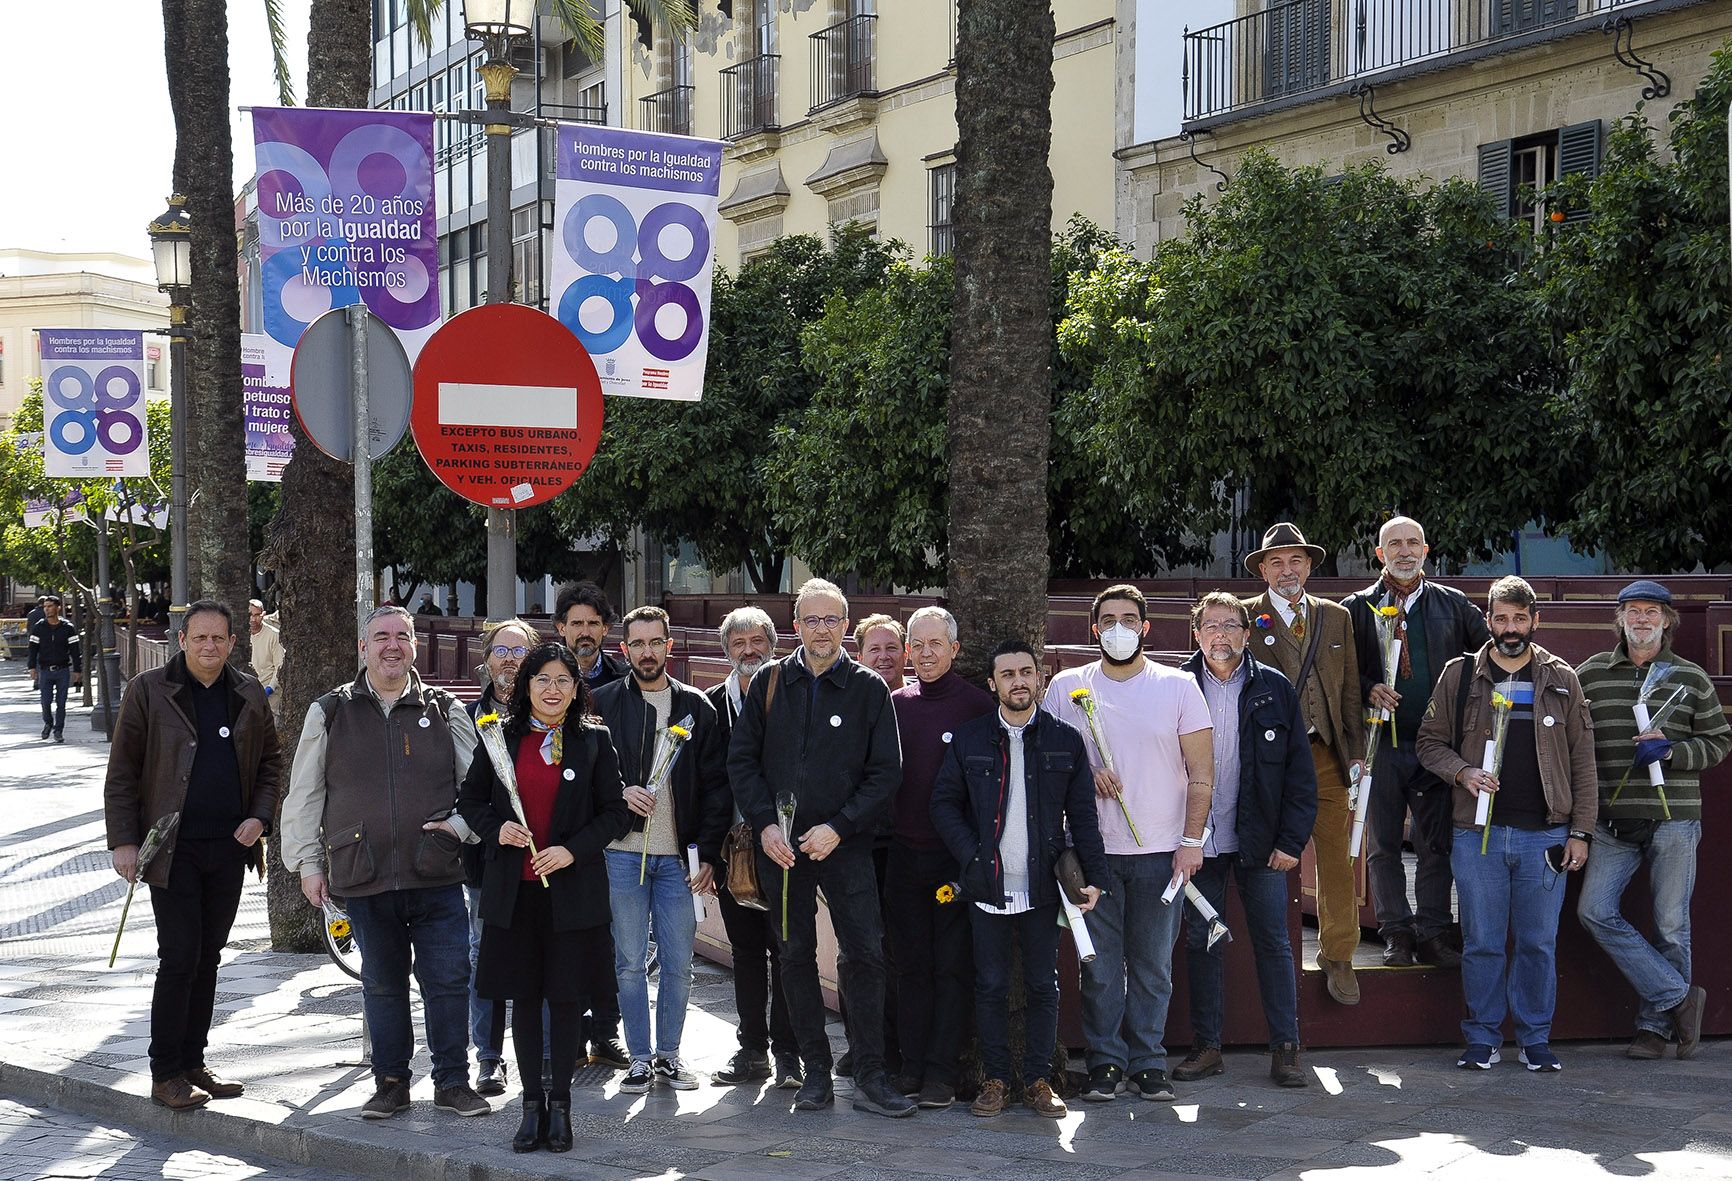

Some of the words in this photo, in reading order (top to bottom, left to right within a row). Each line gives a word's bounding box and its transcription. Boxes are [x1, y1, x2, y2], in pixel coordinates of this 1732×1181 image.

[574, 141, 625, 159] Hombres
[628, 149, 647, 163] por
[650, 149, 660, 163] la
[663, 151, 711, 169] Igualdad
[580, 158, 617, 173] contra
[620, 161, 637, 176] los
[640, 166, 704, 183] machismos
[275, 192, 315, 213] Más
[321, 194, 344, 214] de
[350, 195, 375, 215] 20
[381, 195, 423, 216] años
[280, 220, 310, 241] por
[316, 218, 333, 238] la
[338, 218, 421, 242] Igualdad
[300, 246, 311, 266] y
[317, 245, 375, 263] contra
[381, 243, 406, 264] los
[302, 265, 406, 288] Machismos
[49, 337, 81, 346] Hombres
[83, 338, 95, 347] por
[97, 337, 104, 346] la
[105, 337, 136, 347] Igualdad
[54, 346, 78, 354] contra
[79, 345, 90, 354] los
[91, 345, 132, 354] machismos
[252, 405, 280, 419] trato
[441, 427, 497, 438] EXCEPTO
[500, 428, 525, 438] BUS
[528, 429, 582, 442] URBANO,
[451, 443, 490, 455] TAXIS,
[493, 444, 573, 457] RESIDENTES,
[436, 458, 490, 469] PARKING
[494, 459, 583, 471] SUBTERRÁNEO
[456, 474, 465, 484] Y
[468, 475, 497, 485] VEH.
[501, 475, 563, 486] OFICIALES
